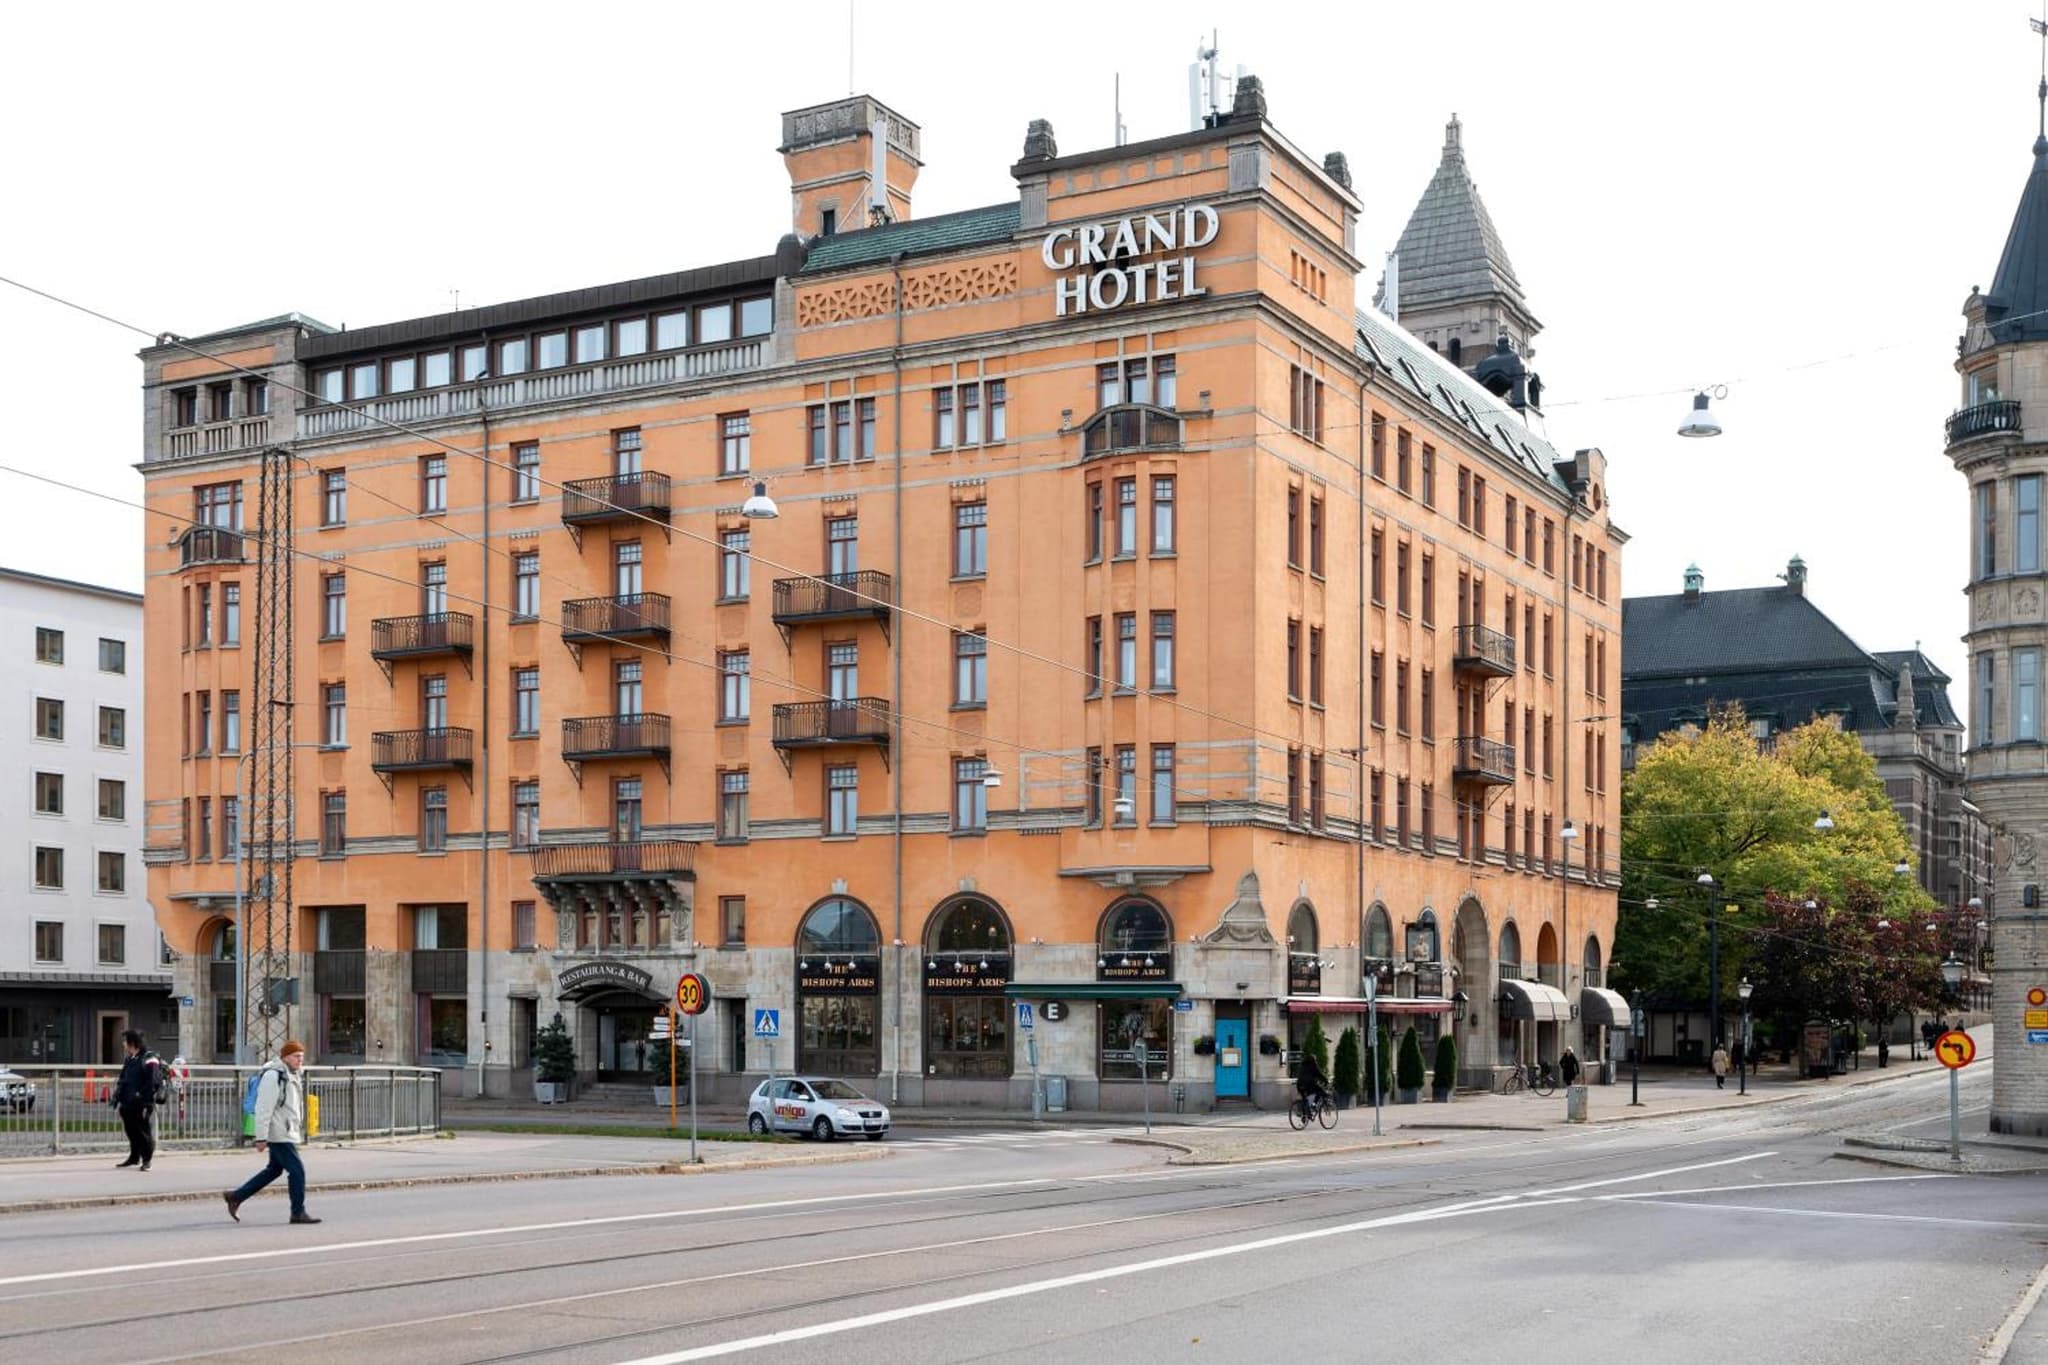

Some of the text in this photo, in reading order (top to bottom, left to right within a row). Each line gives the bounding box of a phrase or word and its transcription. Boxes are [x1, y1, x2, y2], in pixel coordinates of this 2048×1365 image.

[1042, 204, 1220, 270] GRAND
[1055, 256, 1207, 317] HOTEL
[560, 965, 647, 986] RESTAURANG & BAR
[829, 964, 848, 974] THE
[1142, 968, 1166, 976] ARMS
[802, 978, 875, 987] BISHOPS ARMS
[928, 978, 1006, 987] BISHOPS ARMS
[681, 984, 698, 1004] 30
[1047, 1003, 1059, 1019] E
